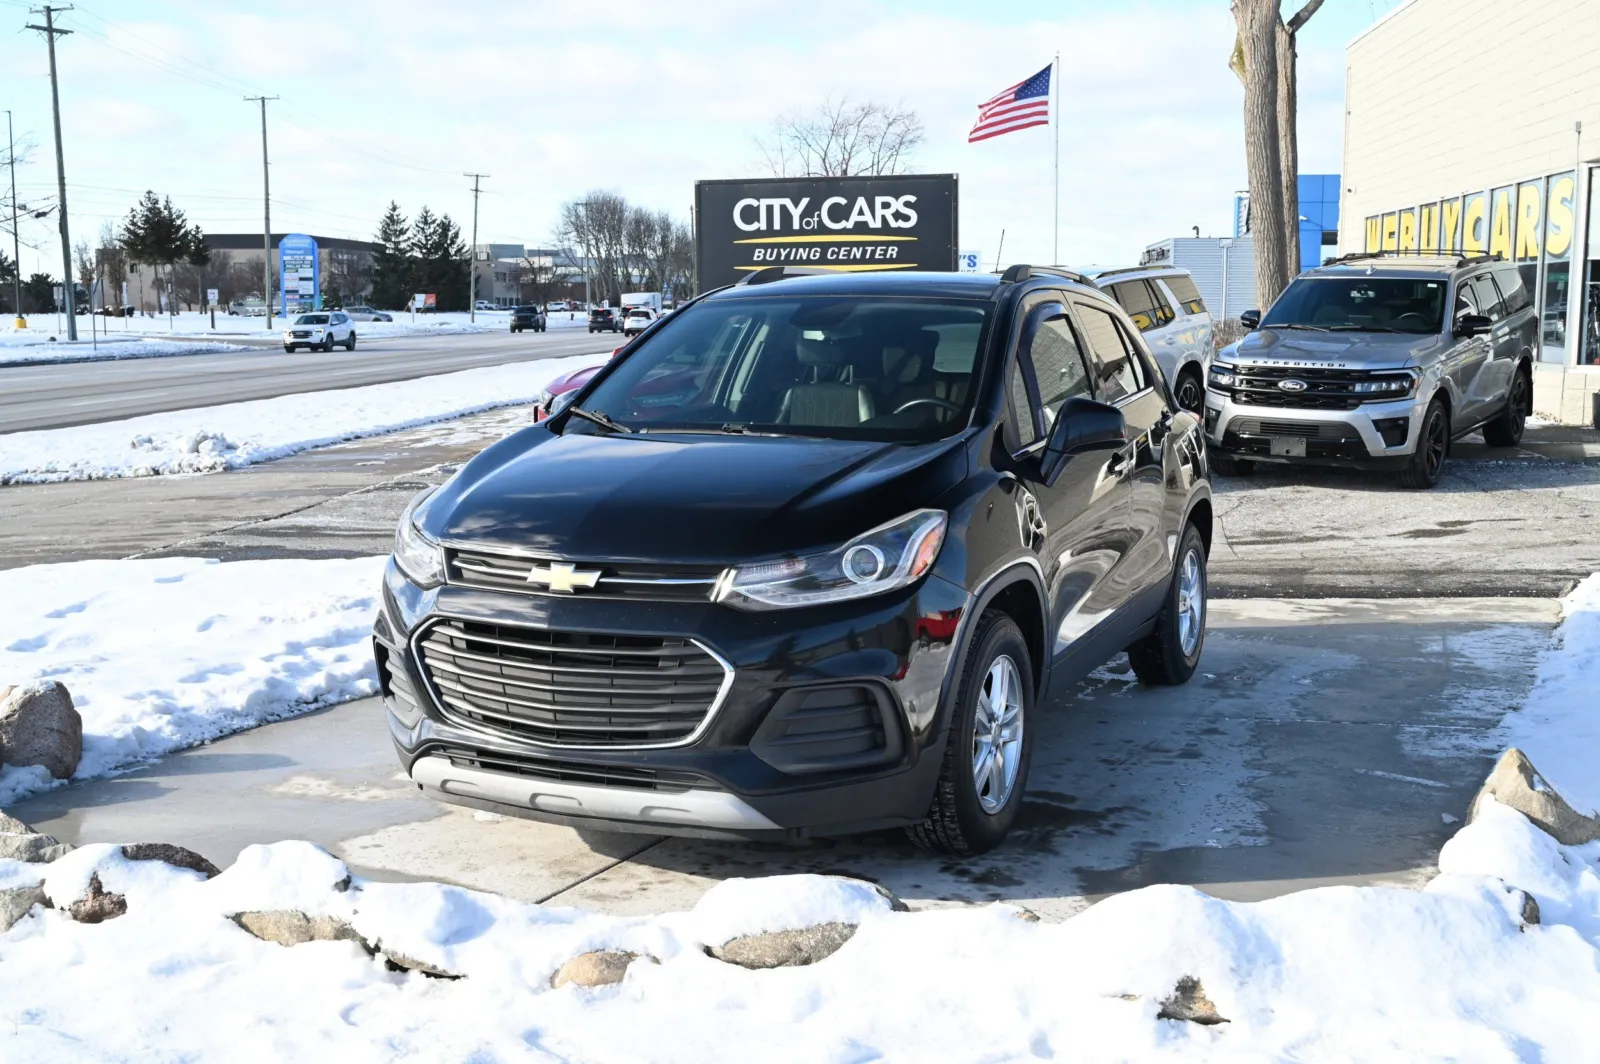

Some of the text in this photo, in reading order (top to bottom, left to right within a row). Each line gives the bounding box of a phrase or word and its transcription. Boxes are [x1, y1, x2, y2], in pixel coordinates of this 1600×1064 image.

[733, 194, 918, 231] CITY of CARS
[753, 246, 898, 261] BUYING CENTER
[1252, 360, 1346, 368] EXPEDITION
